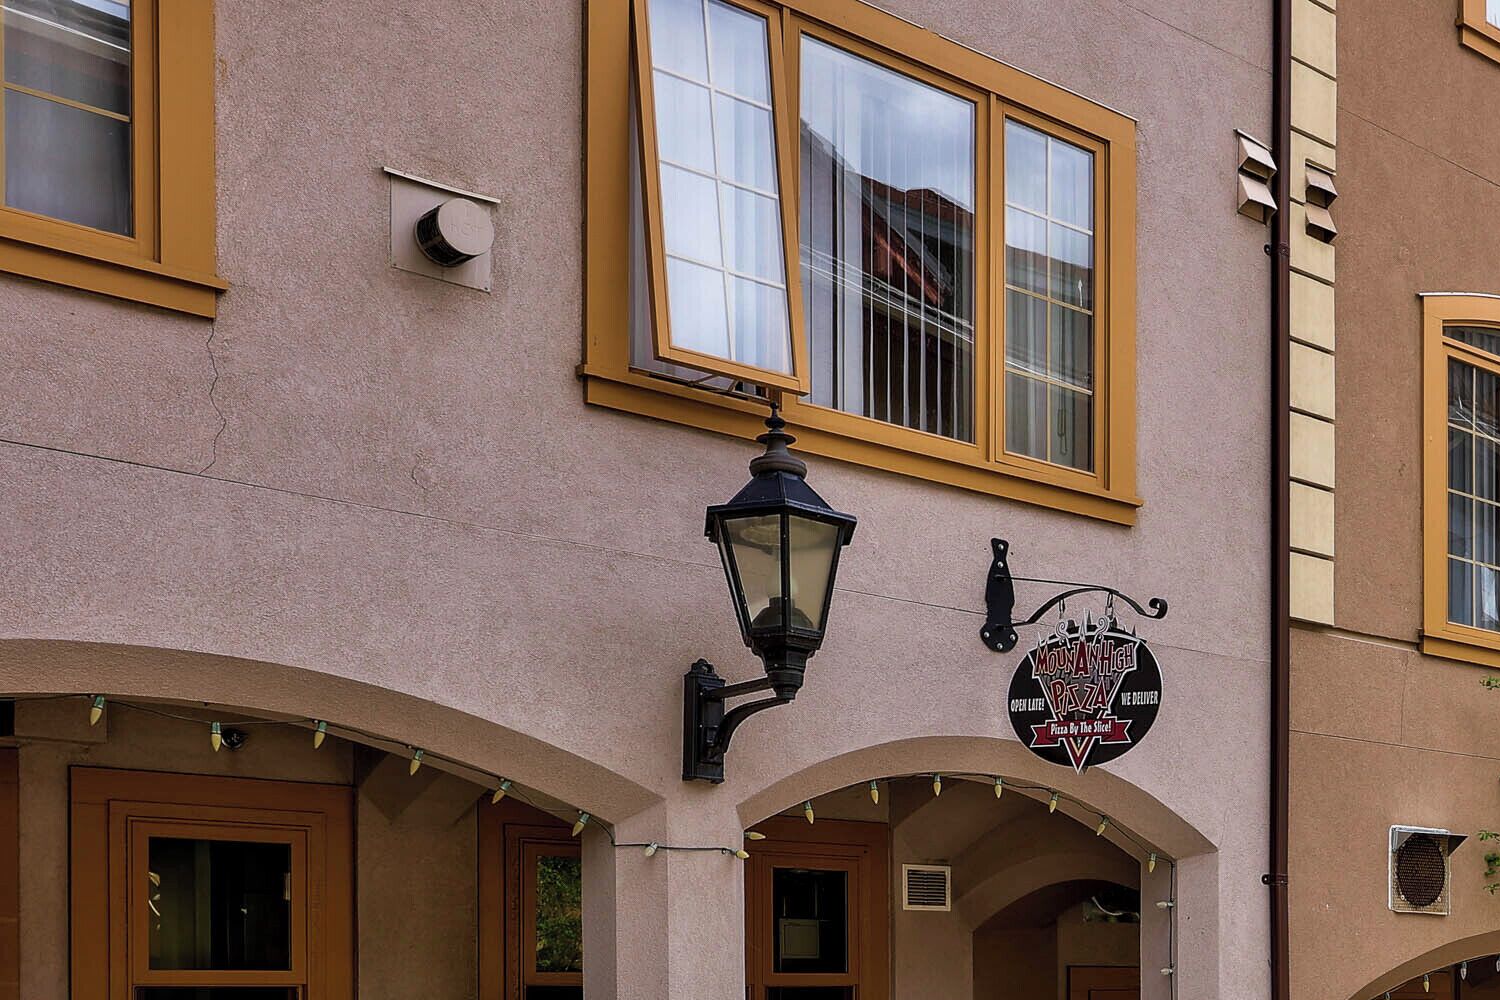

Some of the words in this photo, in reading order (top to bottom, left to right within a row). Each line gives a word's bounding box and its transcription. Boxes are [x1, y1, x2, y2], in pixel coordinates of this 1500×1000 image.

[1051, 678, 1108, 715] PIZZA
[1121, 691, 1132, 706] WE
[1132, 690, 1159, 705] DELIVER
[1010, 698, 1028, 713] OPEN
[1028, 697, 1045, 711] LATE!
[1050, 722, 1068, 735] Pizza
[1069, 722, 1079, 736] By
[1080, 721, 1093, 734] The
[1093, 719, 1112, 733] Slice!
